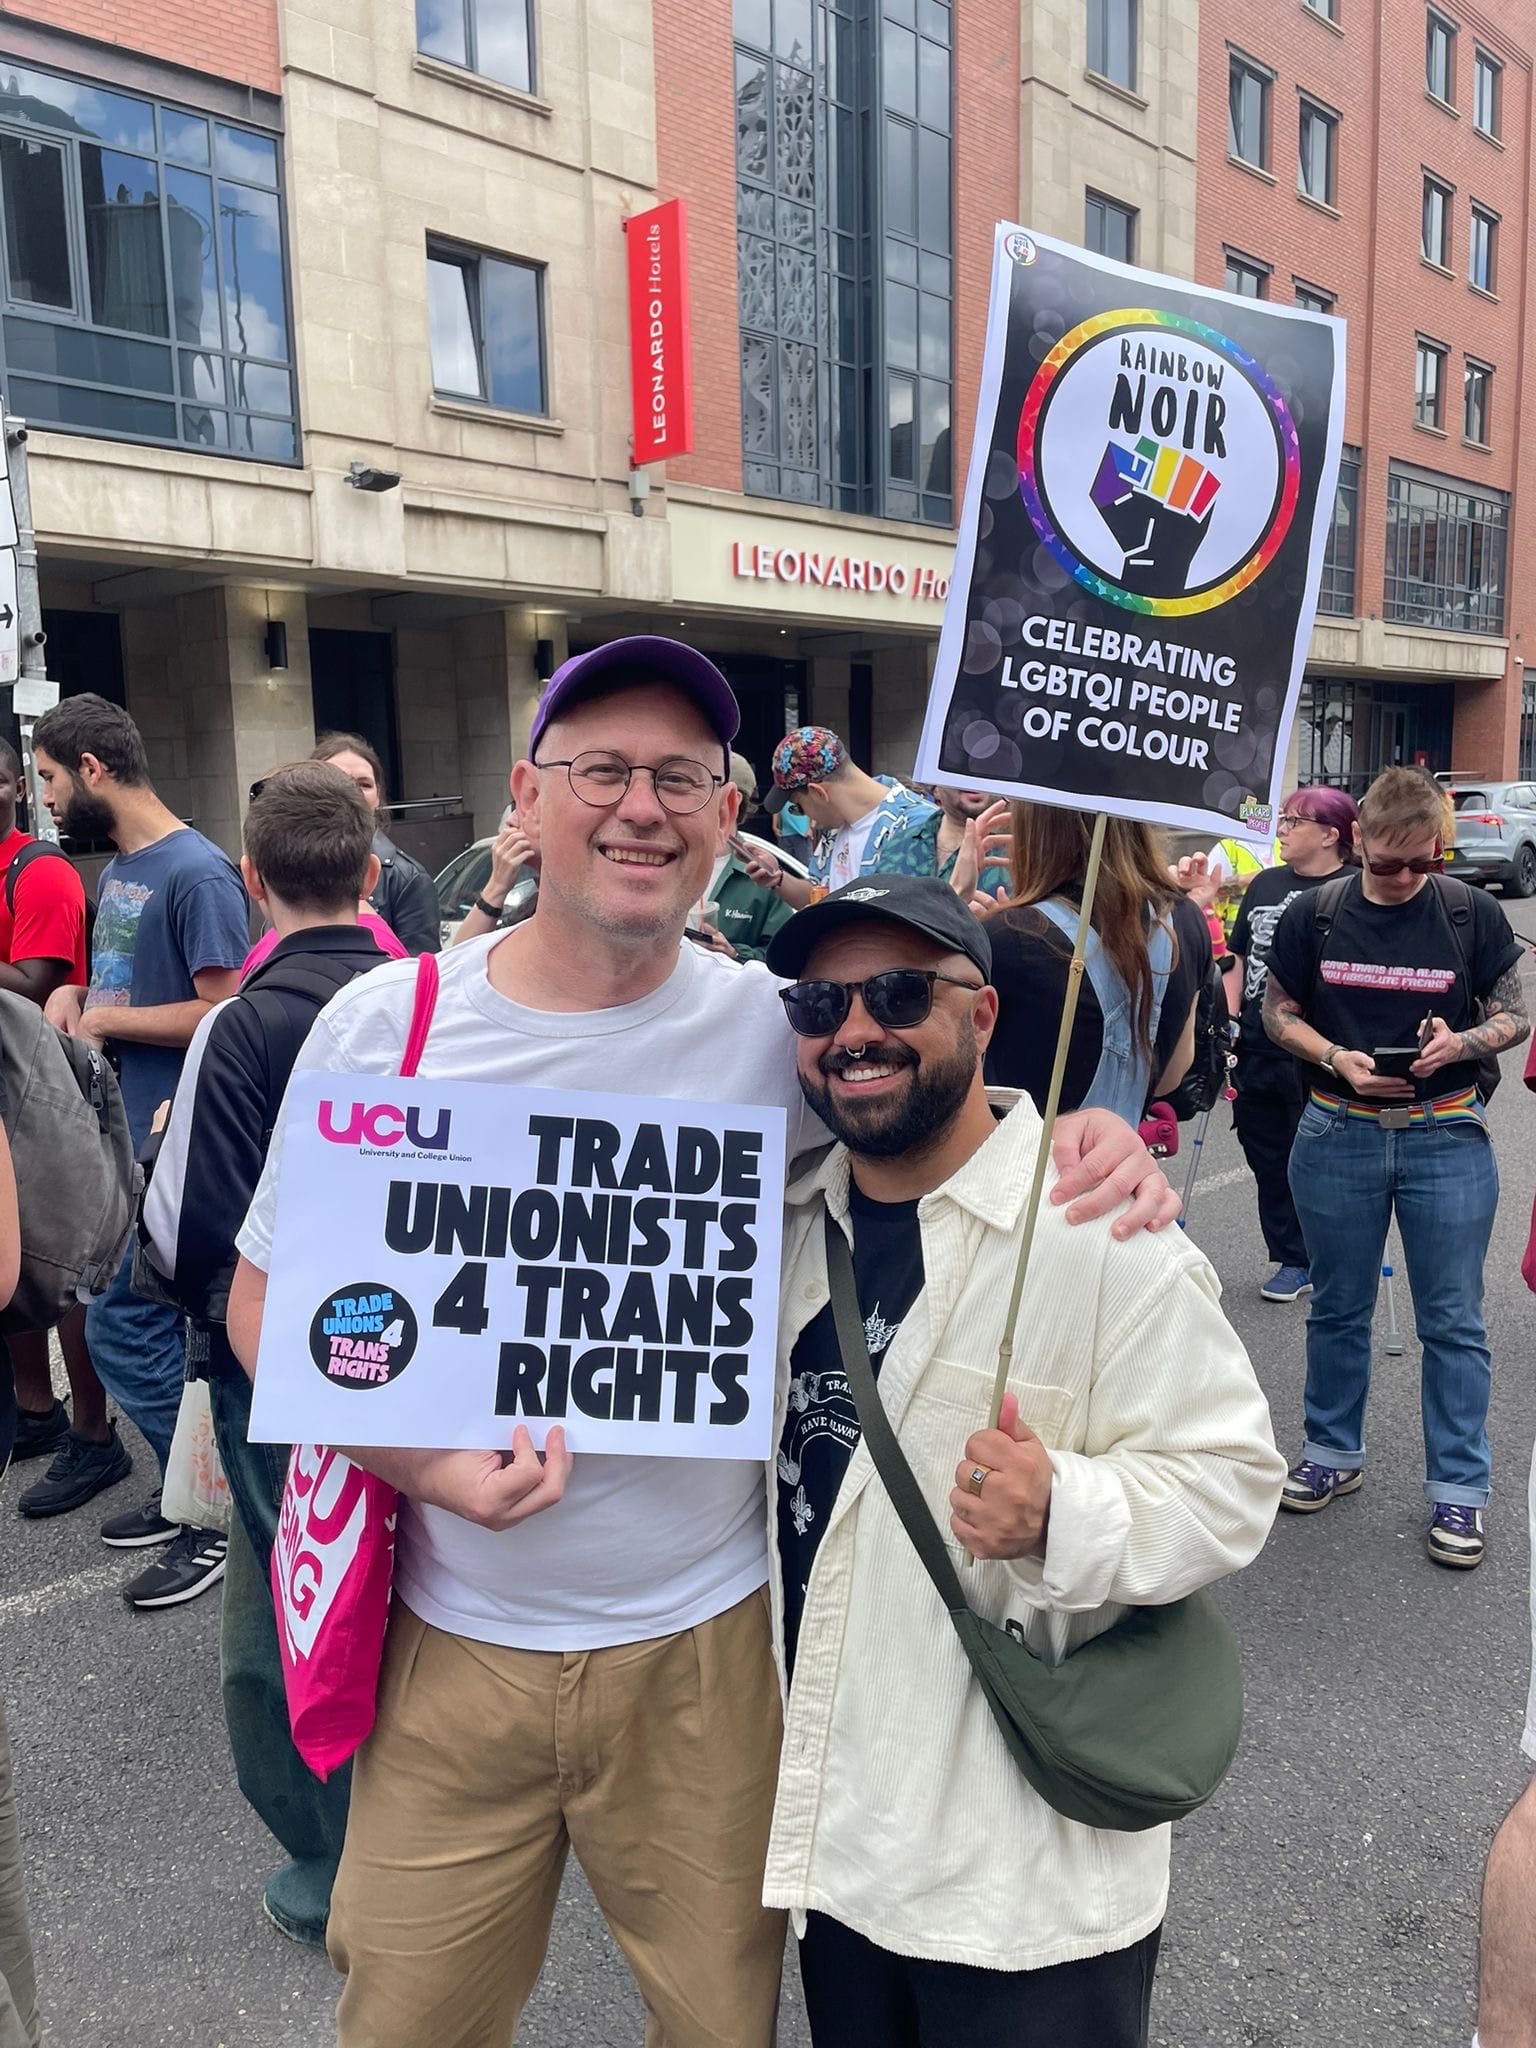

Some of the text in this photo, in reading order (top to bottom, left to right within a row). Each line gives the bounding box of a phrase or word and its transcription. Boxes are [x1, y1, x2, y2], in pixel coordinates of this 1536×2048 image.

[647, 223, 667, 444] LEONARDO Hotels
[1120, 338, 1224, 390] RAINBOW
[1108, 373, 1227, 459] NOIR
[732, 542, 950, 599] LEONARDO Ho
[1021, 615, 1237, 687] CELEBRATING
[1000, 656, 1243, 734] LGBTQI PEOPLE
[1022, 706, 1209, 770] OF COLOUR
[1321, 970, 1449, 990] YOU ABSOLUTE FREAKS
[1350, 962, 1387, 975] TRANS
[1387, 966, 1415, 977] KIDS
[1416, 968, 1456, 980] ALONE
[359, 1148, 472, 1163] University and College Union
[529, 1114, 763, 1199] TRADE
[384, 1180, 758, 1272] UNIONISTS
[323, 1315, 405, 1347] UNIONS 4
[332, 1292, 394, 1317] TRADE
[432, 1261, 754, 1348] 4 TRANS
[327, 1356, 390, 1383] RIGHTS
[329, 1336, 390, 1362] TRANS
[494, 1342, 750, 1425] RIGHTS
[826, 1379, 852, 1394] TRA
[801, 1416, 828, 1435] HAVE
